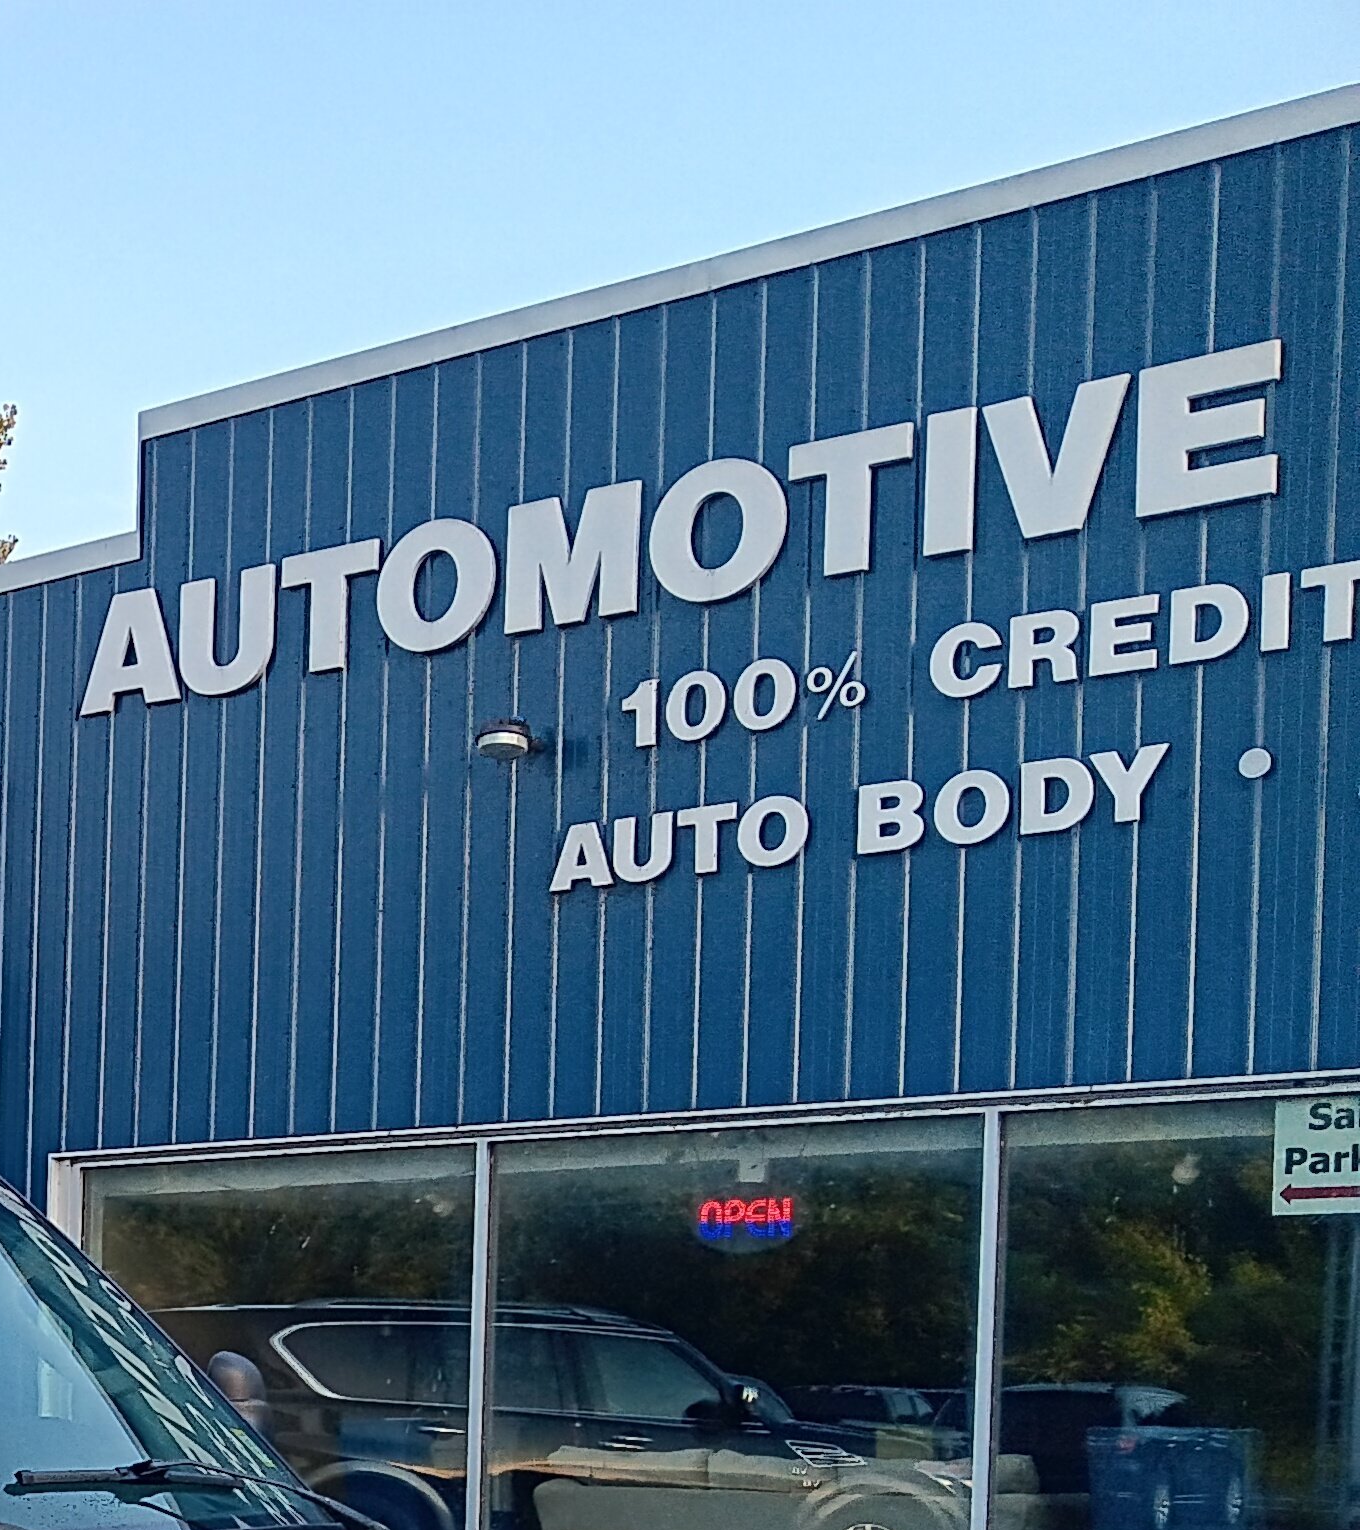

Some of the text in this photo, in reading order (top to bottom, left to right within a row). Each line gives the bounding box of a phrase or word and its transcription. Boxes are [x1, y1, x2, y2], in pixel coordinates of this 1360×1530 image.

[79, 338, 1282, 718] AUTOMOTIVE
[621, 560, 1360, 747] 100% CREDIT
[549, 743, 1171, 892] AUTO BODY
[1308, 1102, 1360, 1131] Sa
[699, 1196, 794, 1242] OPEN
